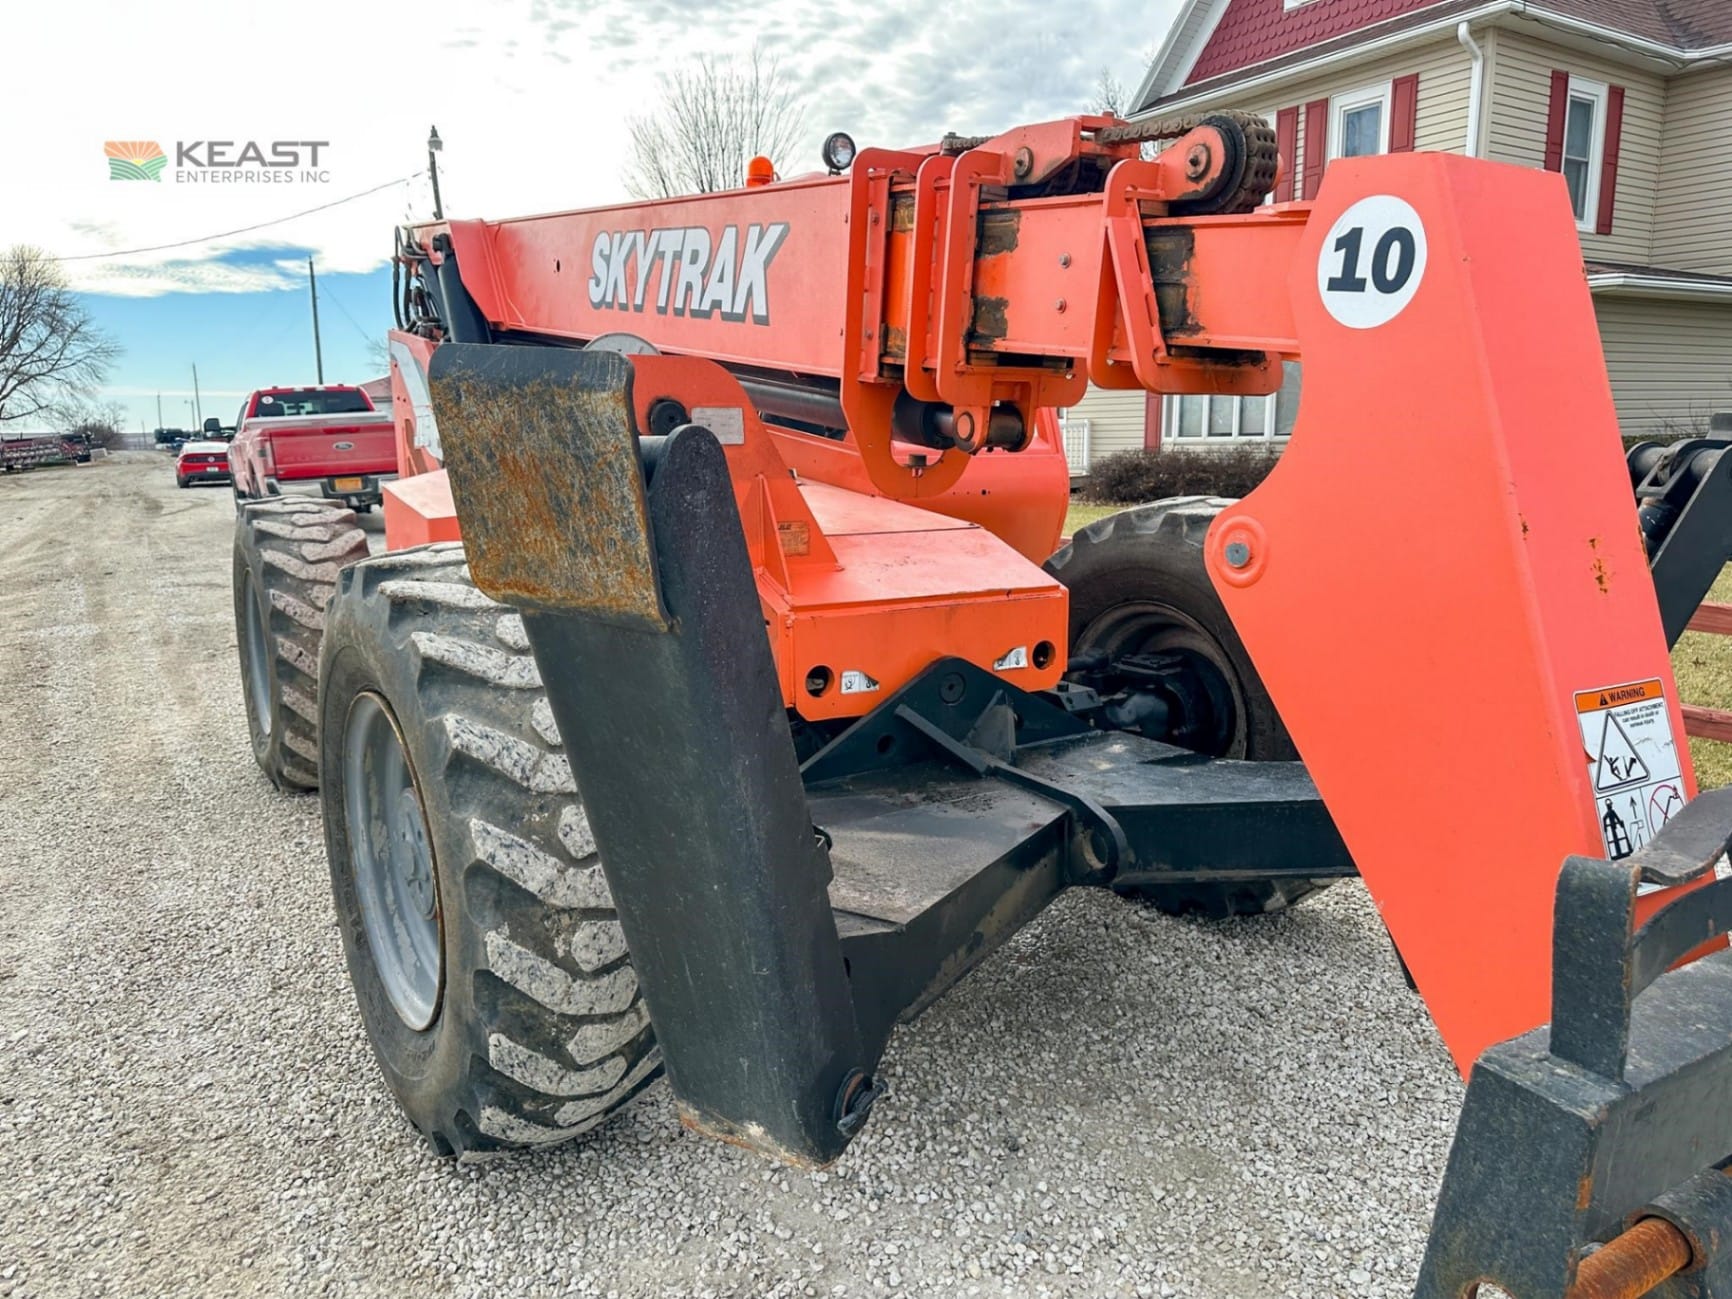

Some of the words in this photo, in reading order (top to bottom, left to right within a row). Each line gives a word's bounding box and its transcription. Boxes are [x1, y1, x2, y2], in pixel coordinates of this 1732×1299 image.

[588, 221, 790, 326] SKYTRAK
[1326, 226, 1416, 295] 10
[1608, 686, 1646, 703] WARNING
